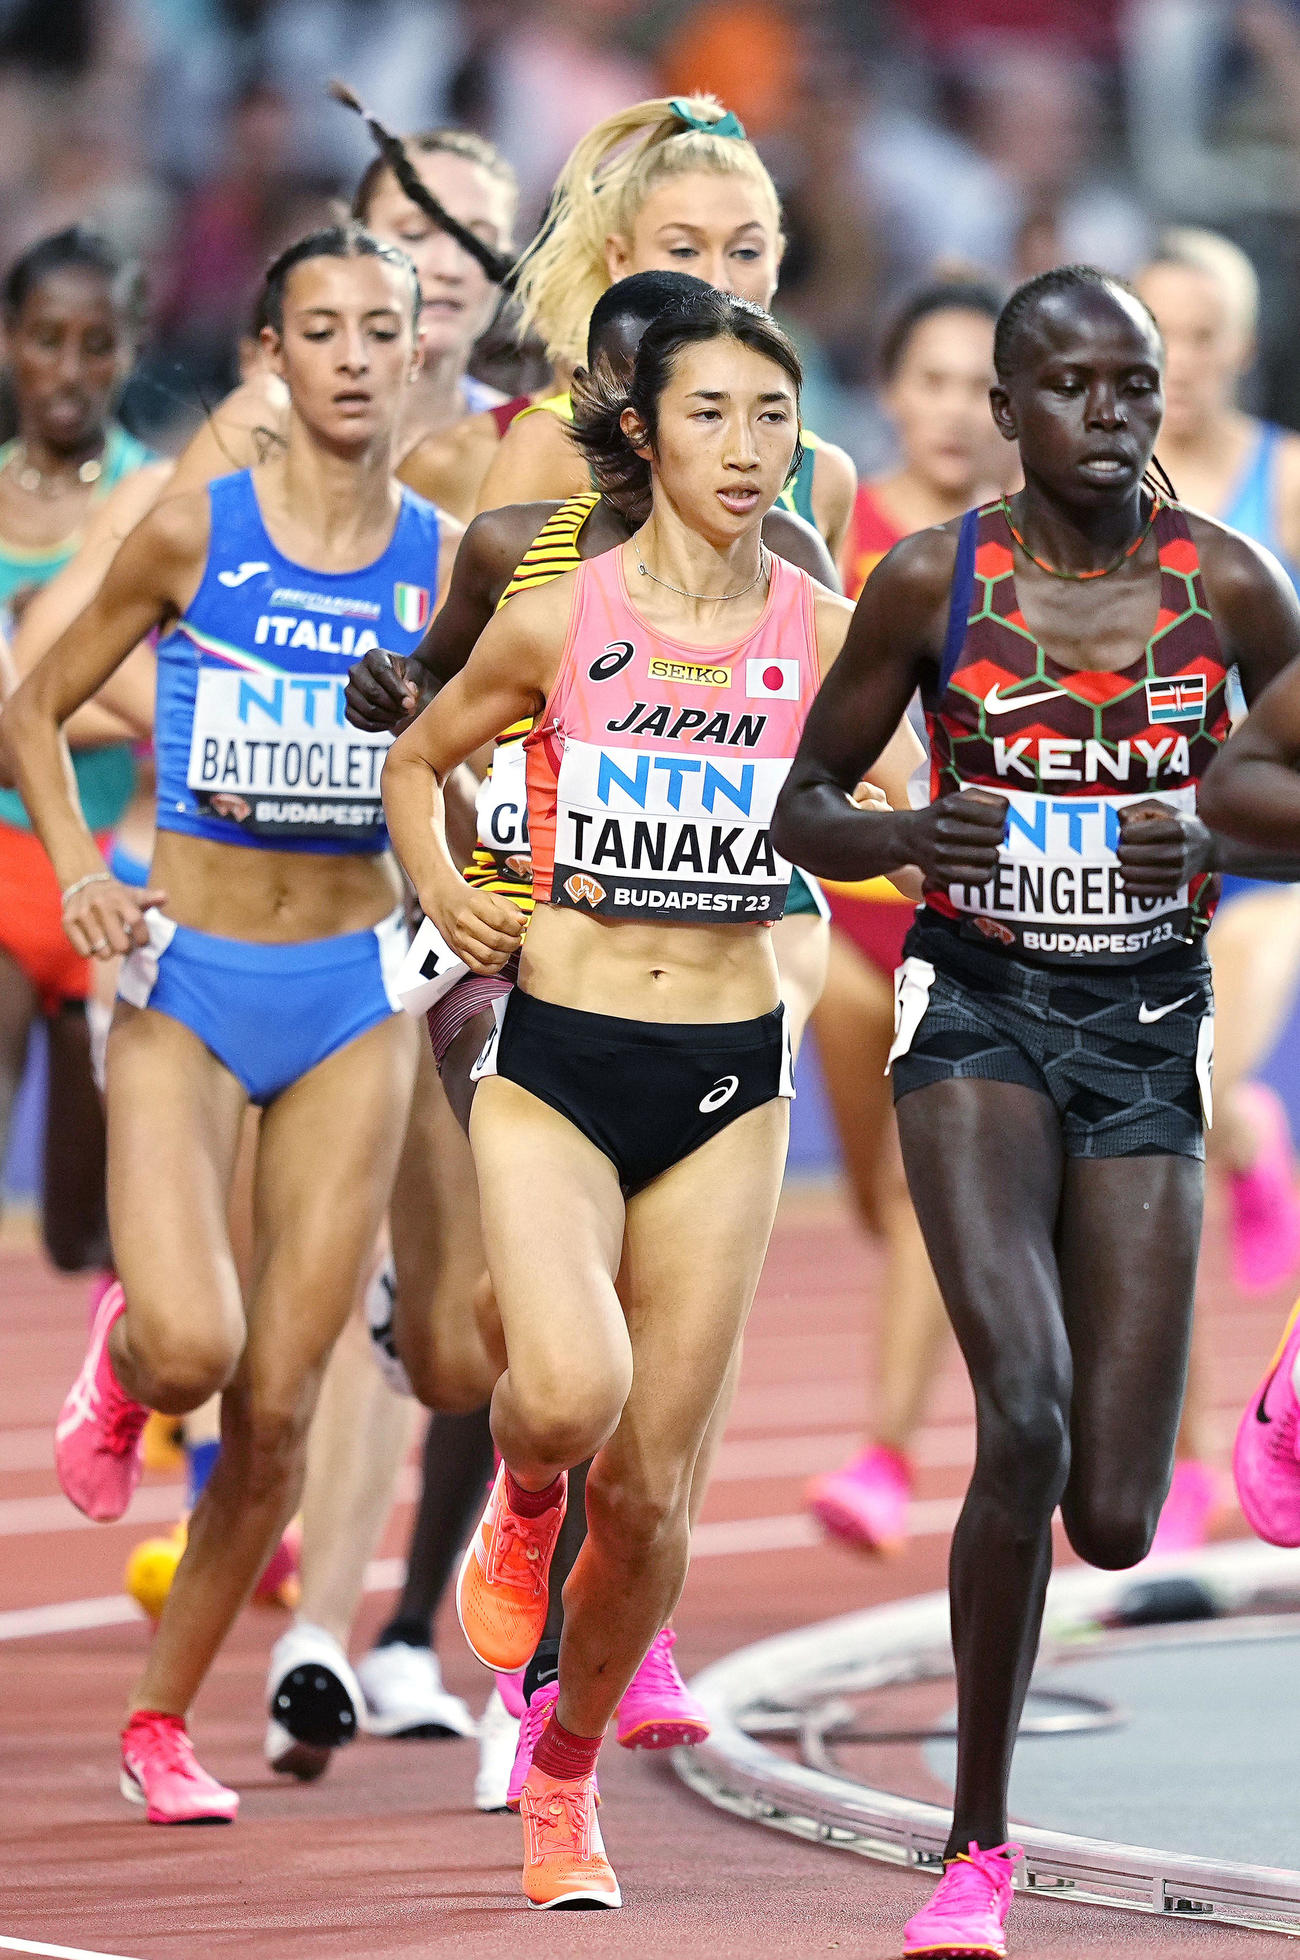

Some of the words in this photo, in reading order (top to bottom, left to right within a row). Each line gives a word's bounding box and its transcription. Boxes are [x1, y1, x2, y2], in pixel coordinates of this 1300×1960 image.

[254, 615, 380, 658] ITALIA
[651, 661, 728, 684] SEIKO
[605, 701, 768, 748] JAPAN
[202, 738, 390, 790] BATTOCLET
[993, 736, 1190, 782] KENYA
[597, 751, 755, 817] NTN
[256, 802, 374, 826] BUDAPEST
[568, 810, 777, 876] TANAKA
[614, 887, 742, 912] BUDAPEST
[744, 895, 770, 912] 23
[1022, 931, 1150, 953] BUDAPEST
[1151, 922, 1174, 944] 23
